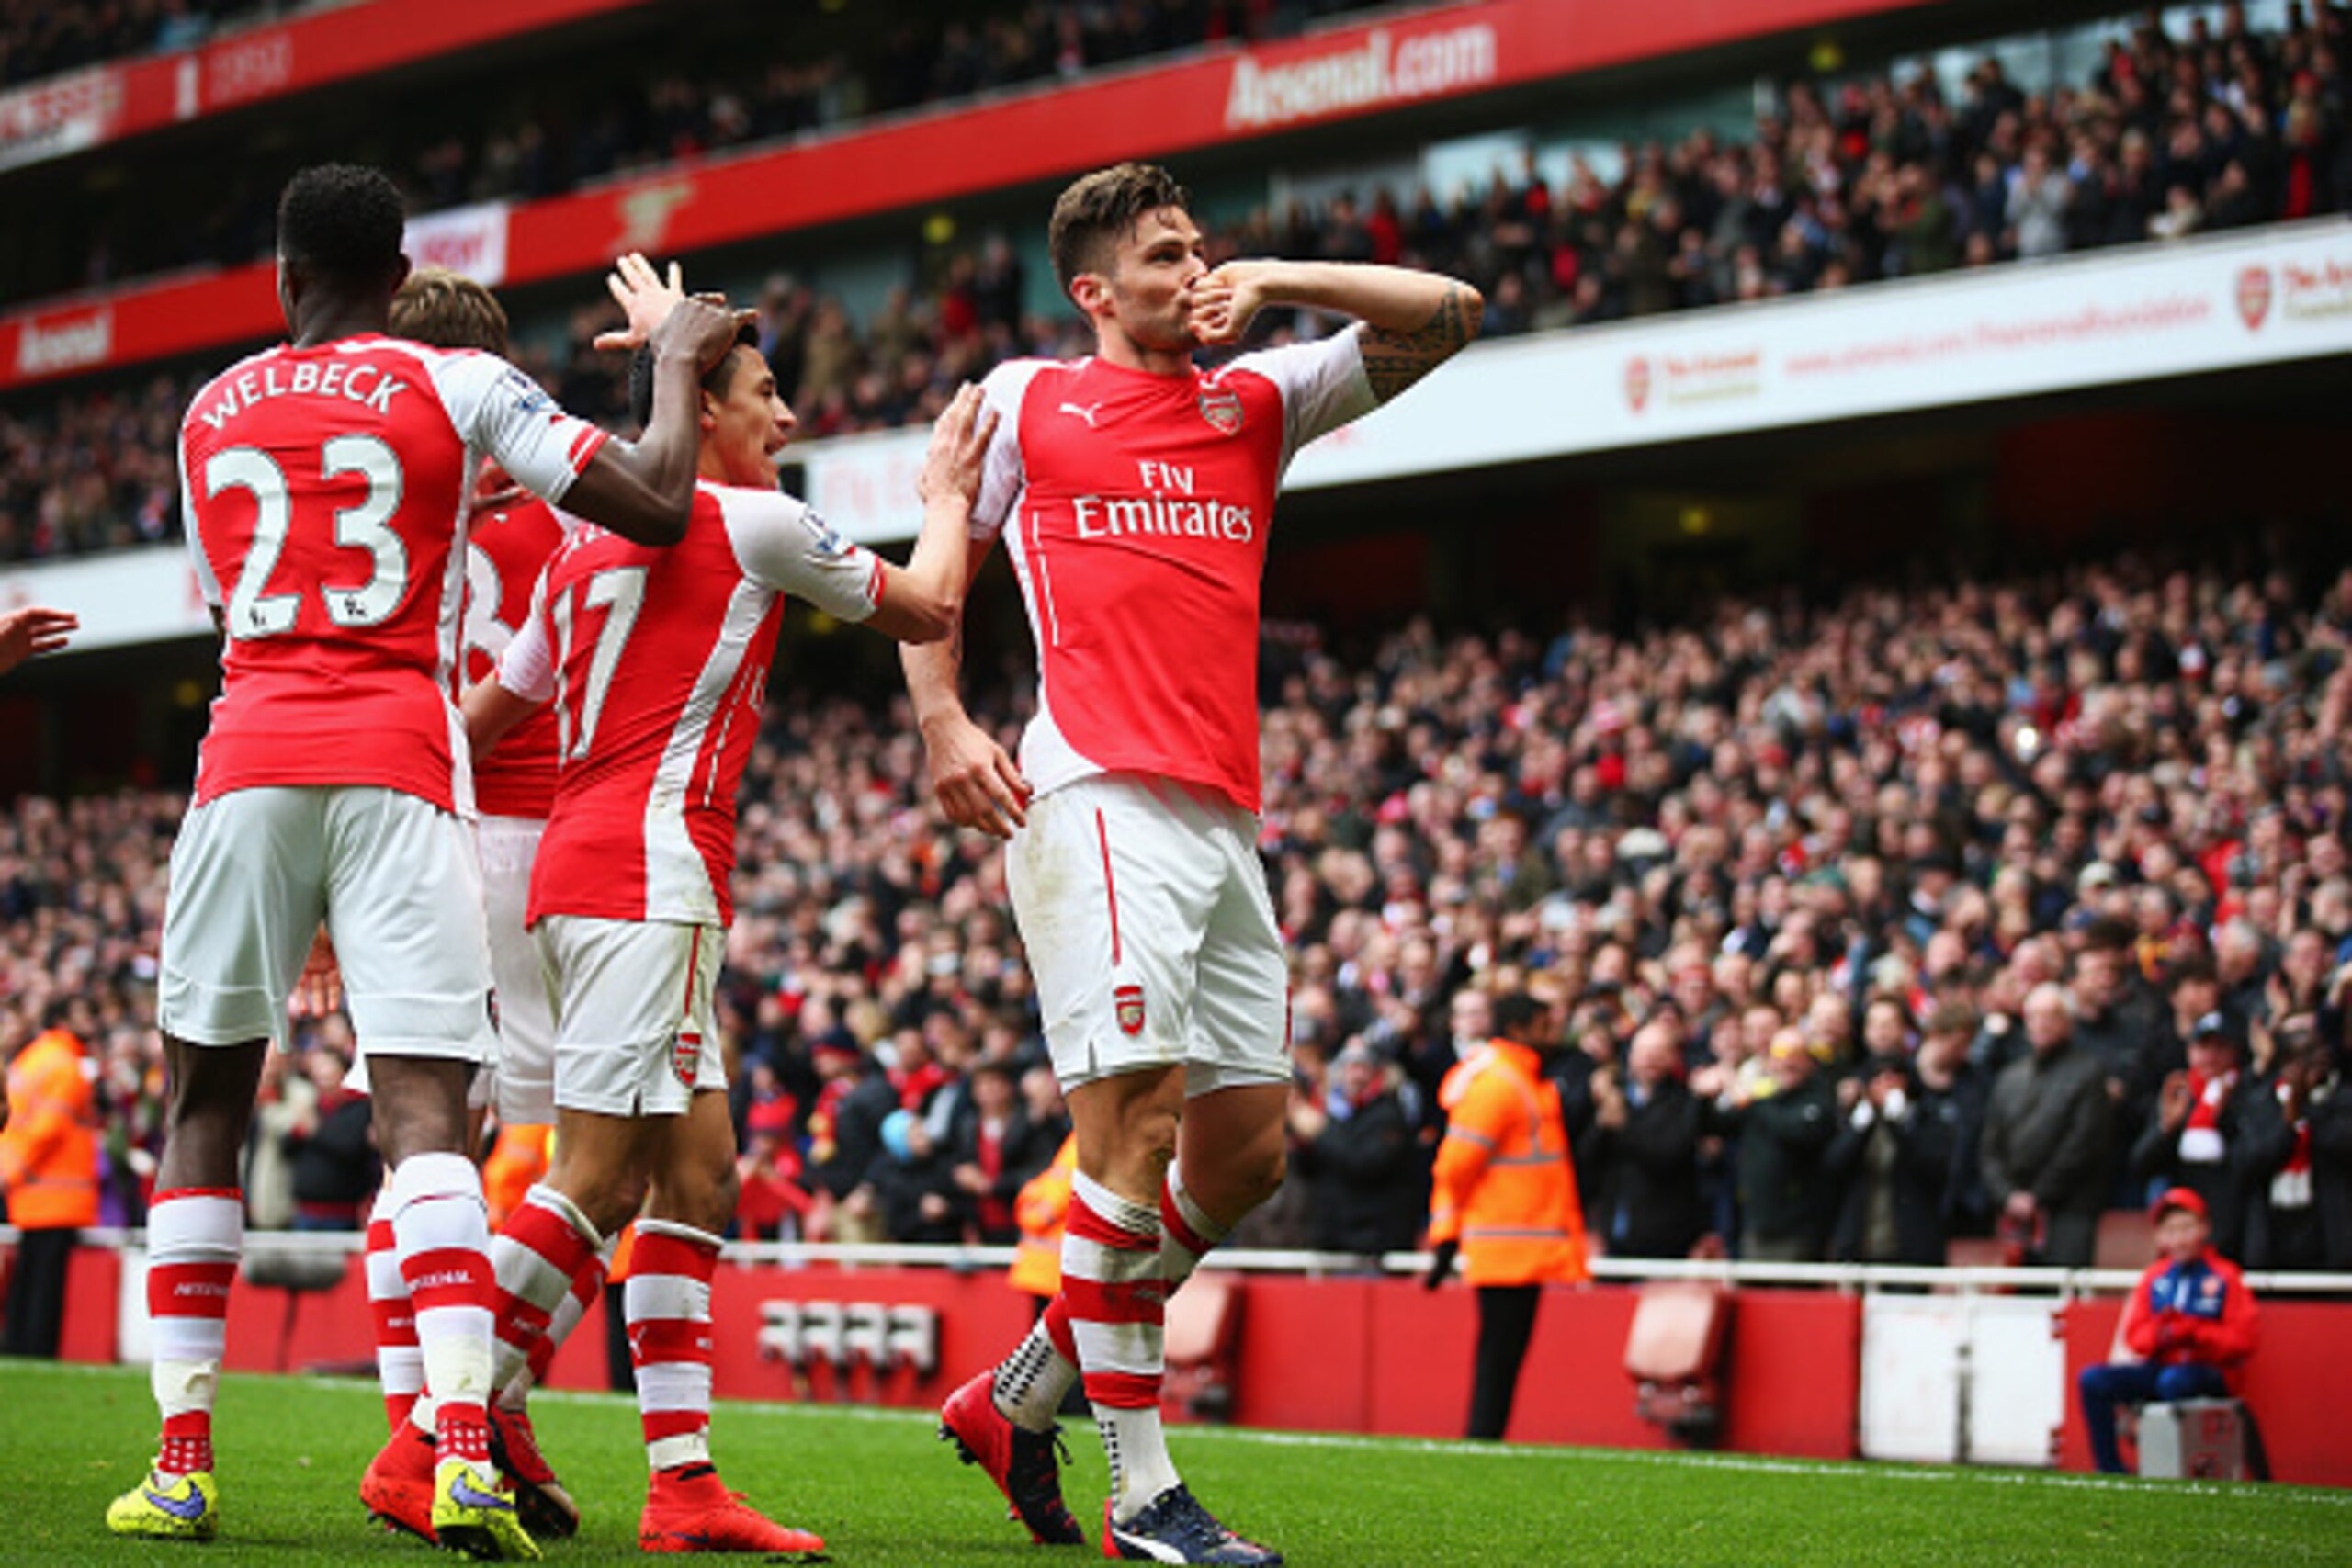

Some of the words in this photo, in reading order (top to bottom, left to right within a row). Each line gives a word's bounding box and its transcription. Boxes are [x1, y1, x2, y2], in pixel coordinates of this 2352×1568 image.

[1225, 24, 1497, 130] Arsenal.com
[200, 362, 408, 431] WELBECK
[1072, 490, 1253, 544] Emirates
[1139, 459, 1193, 496] Fly
[204, 433, 409, 641] 23
[551, 565, 650, 773] 17
